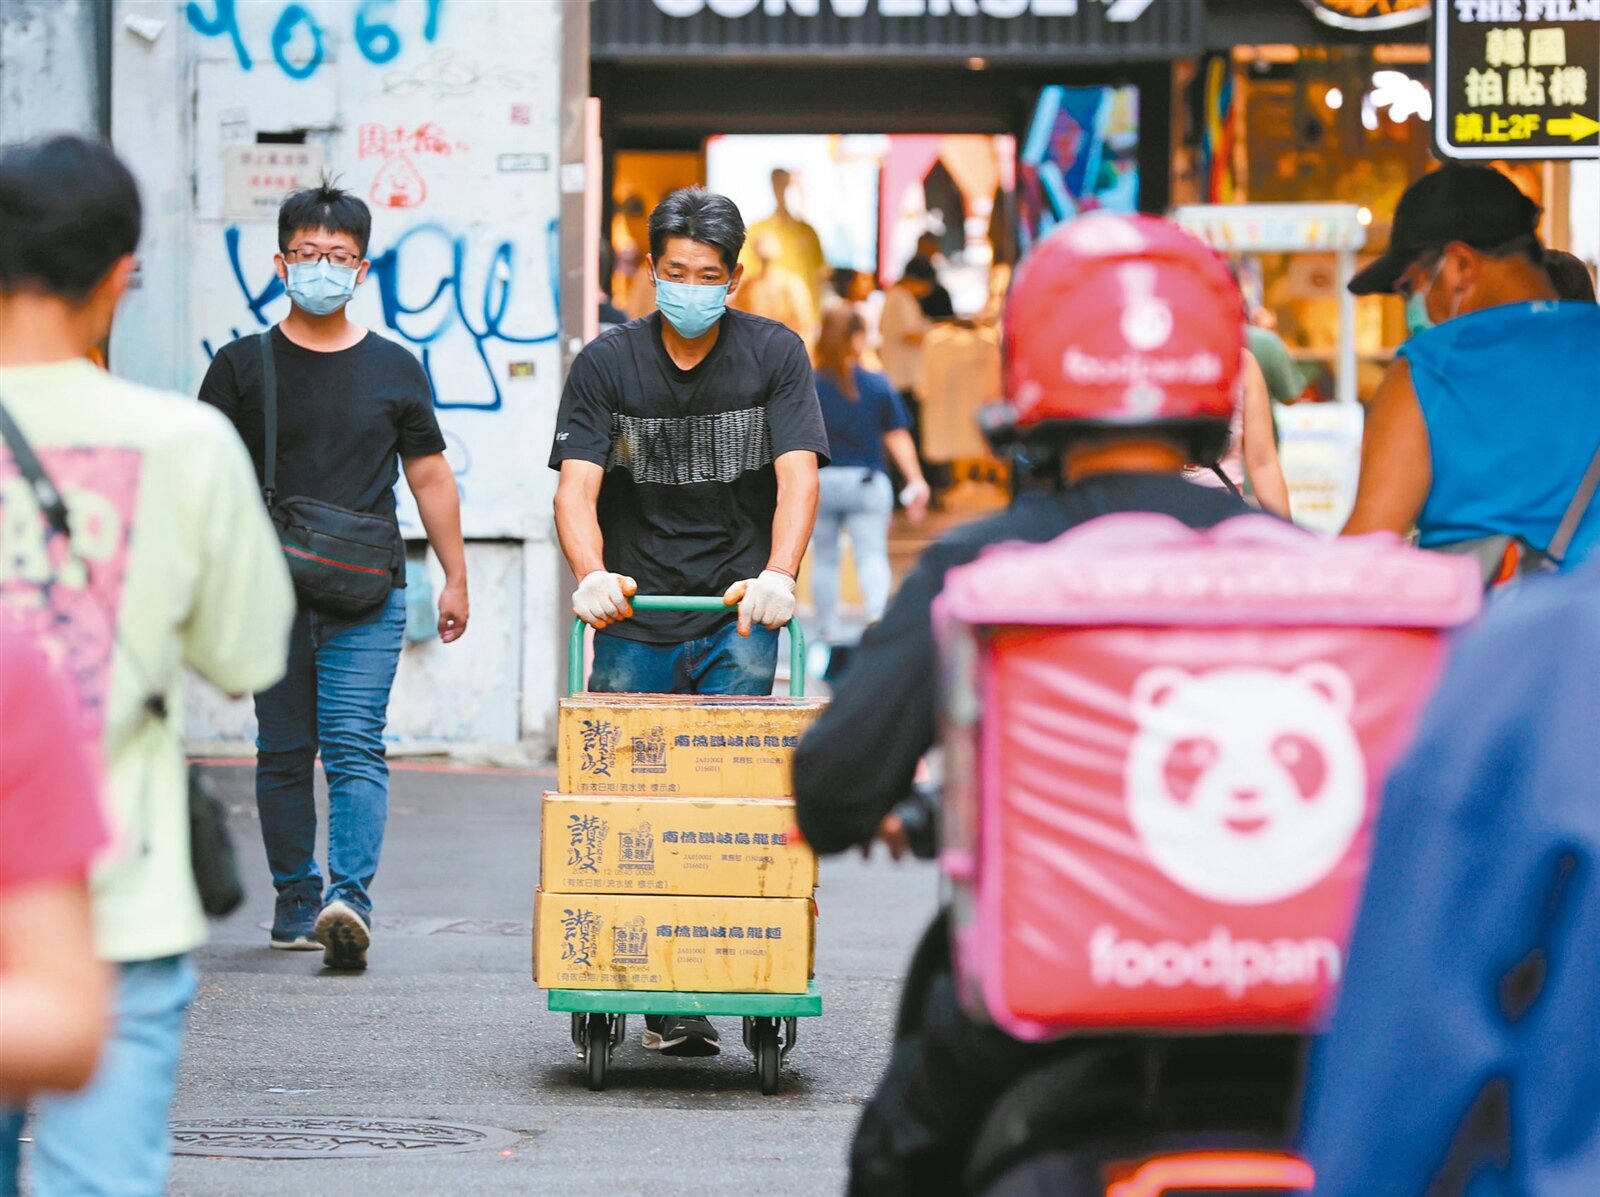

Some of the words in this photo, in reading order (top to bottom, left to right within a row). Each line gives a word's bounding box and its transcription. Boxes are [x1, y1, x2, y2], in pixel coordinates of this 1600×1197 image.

[1454, 0, 1522, 22] THE
[1485, 27, 1566, 67] 韓國
[1464, 67, 1588, 107] 拍貼機
[1455, 112, 1541, 142] 請上2F
